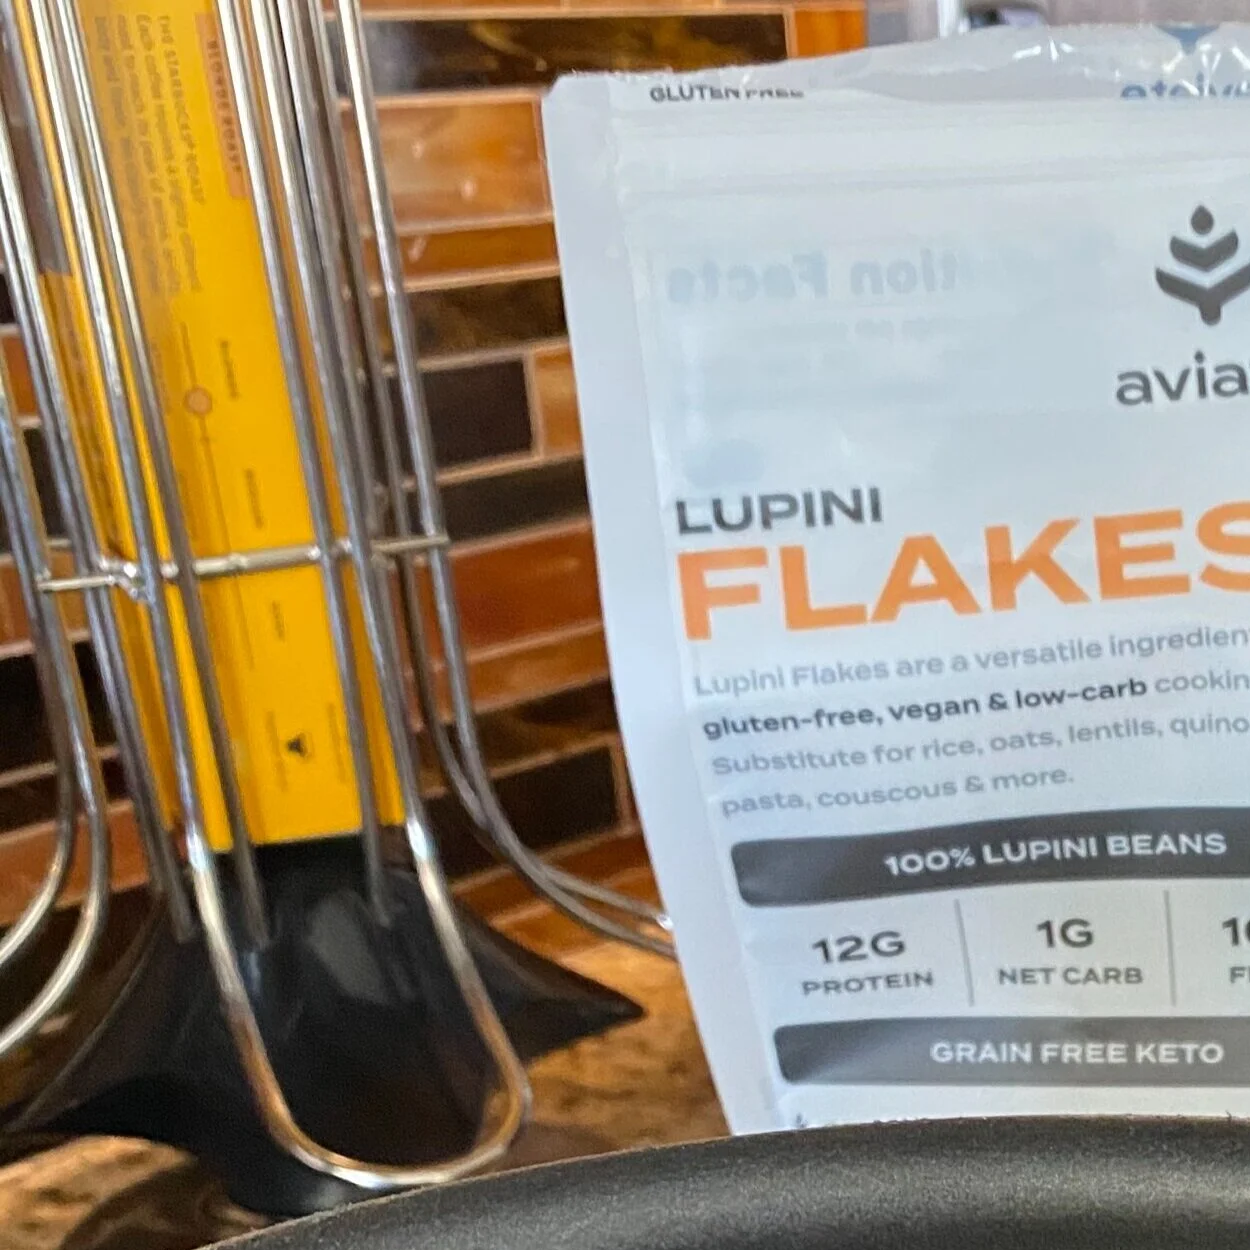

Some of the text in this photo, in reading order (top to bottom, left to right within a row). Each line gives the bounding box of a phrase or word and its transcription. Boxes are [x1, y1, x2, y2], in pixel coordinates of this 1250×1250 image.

[650, 83, 740, 103] GLUTEN
[676, 486, 883, 535] LUPINI
[694, 667, 784, 698] Lupini
[792, 658, 890, 687] Flakes
[896, 655, 943, 677] are
[951, 654, 969, 672] a
[973, 635, 1102, 670] versatile
[703, 708, 884, 741] gluten-free,
[888, 697, 980, 722] vegan
[988, 692, 1008, 711] &
[1016, 678, 1147, 709] low-carb
[711, 750, 867, 775] Substitute
[873, 744, 915, 763] for
[923, 739, 983, 760] rice,
[990, 729, 1062, 751] oats,
[1069, 717, 1163, 743] lentils,
[722, 767, 1074, 819] pasta, couscous & more.
[884, 833, 1227, 876] 100% LUPINI BEANS
[812, 930, 905, 964] 12G
[1037, 918, 1094, 949] 1G
[802, 971, 933, 996] PROTEIN
[998, 967, 1143, 985] NET CARB
[930, 1041, 1225, 1063] GRAIN FREE KETO
